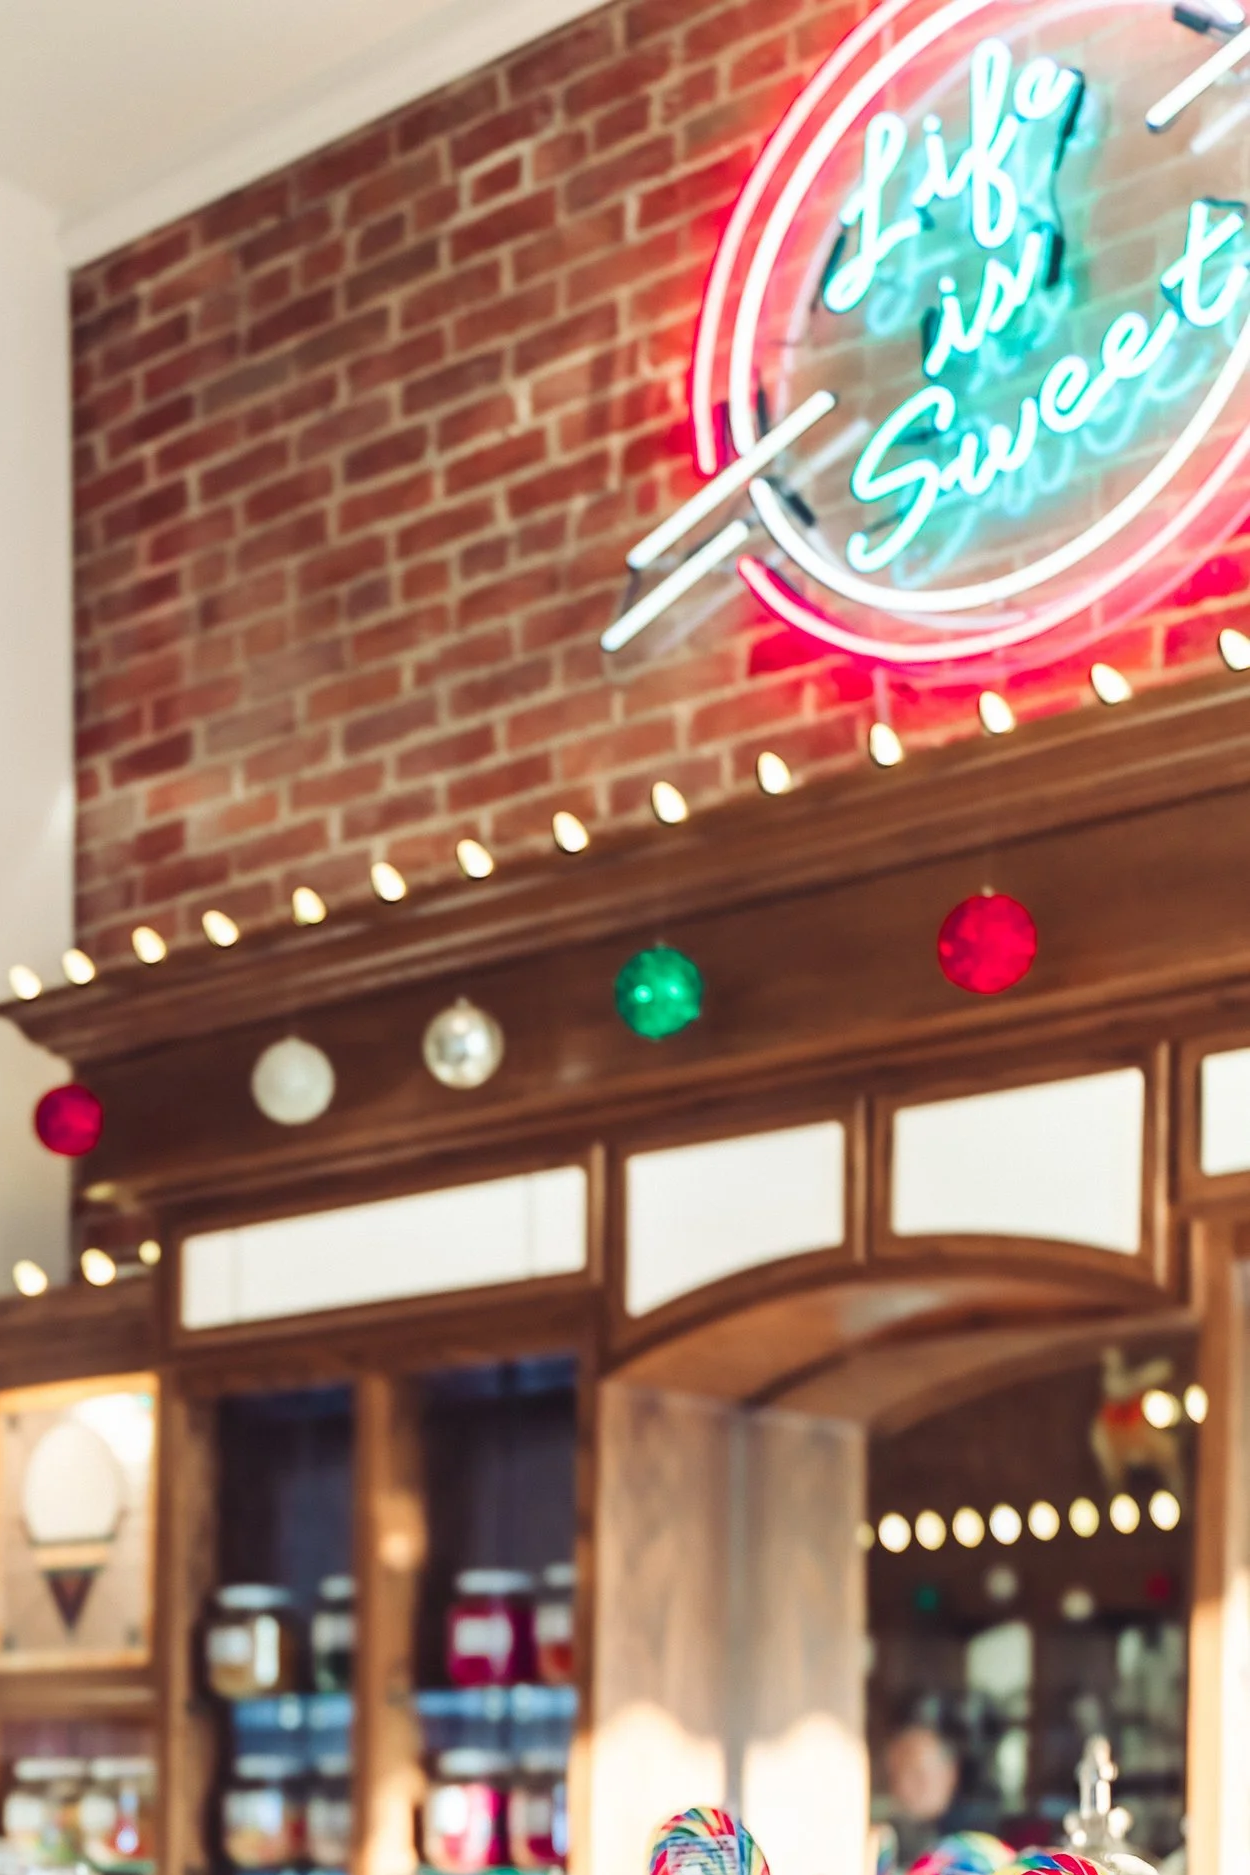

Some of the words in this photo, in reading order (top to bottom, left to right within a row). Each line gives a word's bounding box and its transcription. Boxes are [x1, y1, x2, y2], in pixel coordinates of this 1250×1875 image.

[824, 37, 1082, 313] Life
[924, 226, 1044, 377] is
[846, 199, 1250, 573] Sweet
